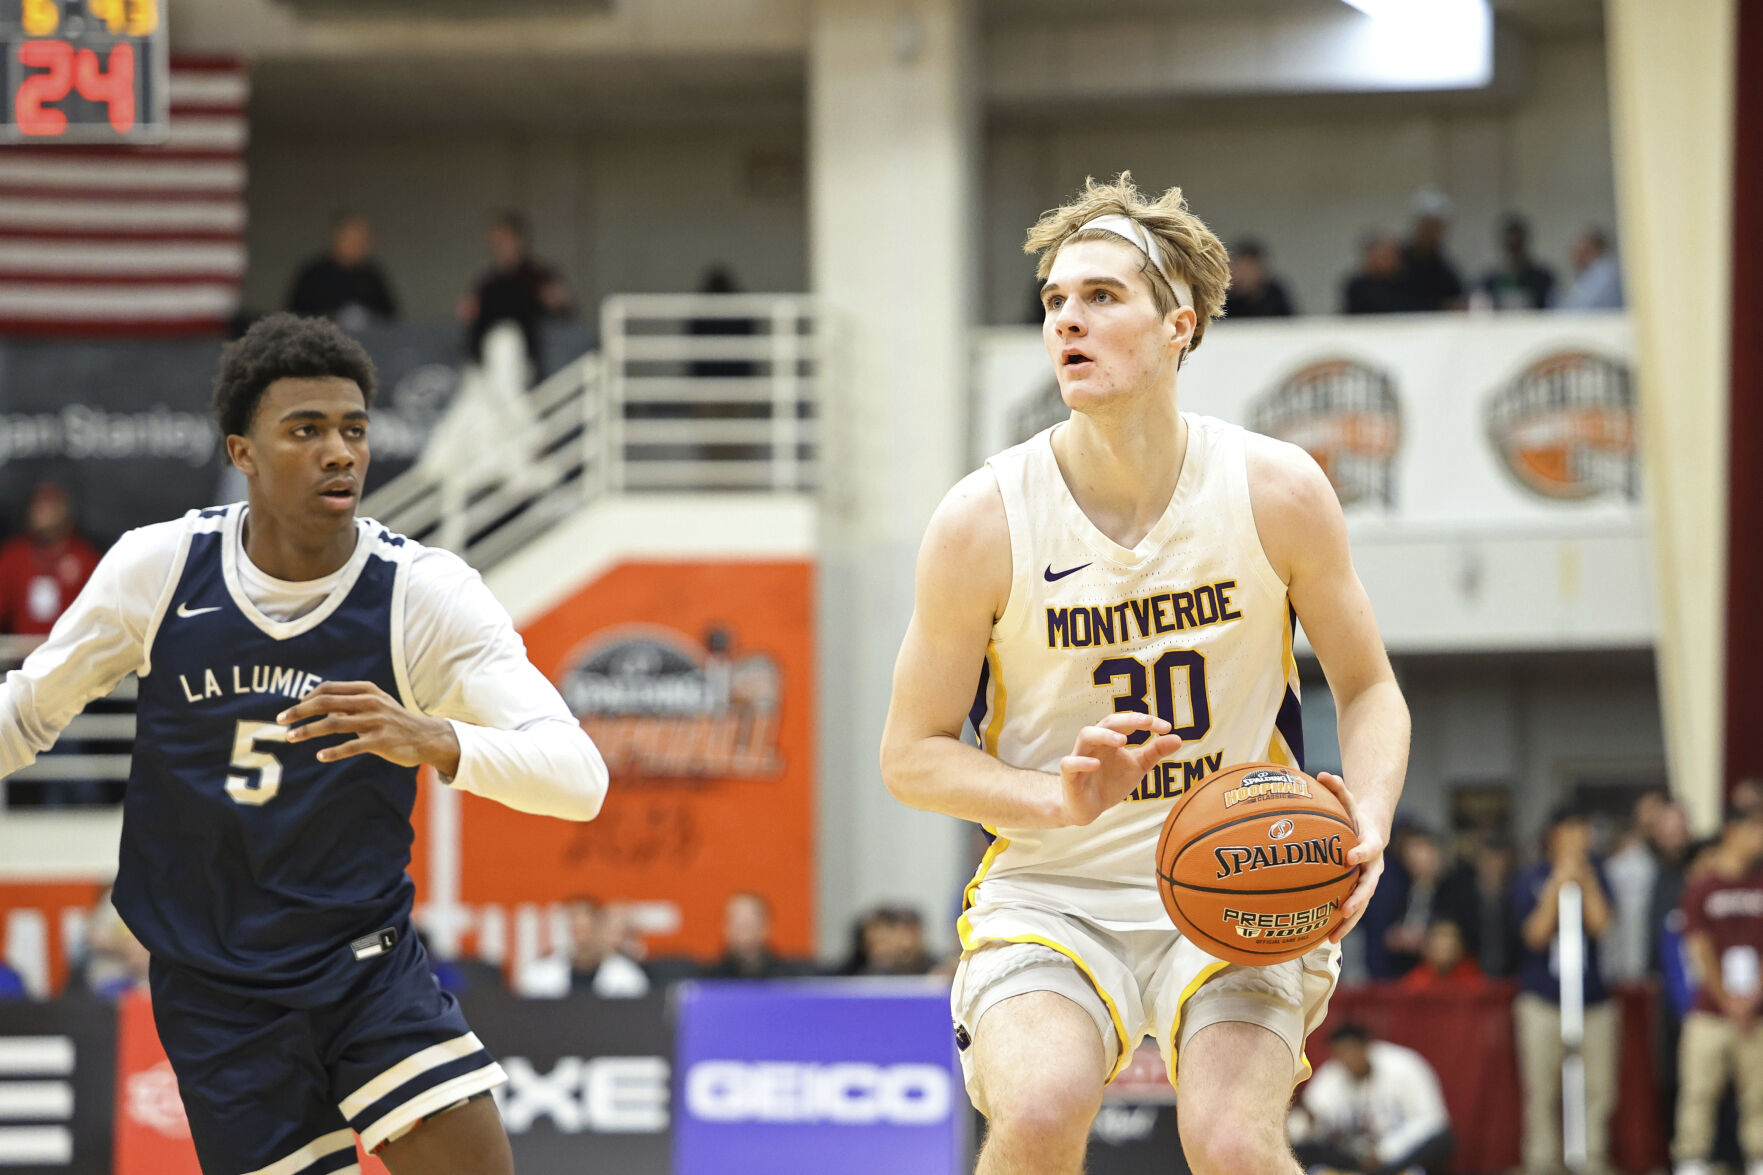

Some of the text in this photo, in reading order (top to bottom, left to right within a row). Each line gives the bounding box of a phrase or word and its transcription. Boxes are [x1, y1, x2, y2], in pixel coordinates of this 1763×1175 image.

[15, 40, 135, 136] 24
[1046, 579, 1243, 648] MONTVERDE
[180, 669, 223, 702] LA
[1091, 648, 1212, 747] 30
[224, 719, 291, 807] 5
[1243, 775, 1288, 787] SPALDING
[1224, 782, 1313, 809] HOOPHALL
[1214, 834, 1343, 880] SPALDING
[1222, 896, 1340, 928] PRECISION
[1264, 918, 1329, 938] 1000
[384, 935, 393, 946] L
[685, 1060, 951, 1125] GEICO
